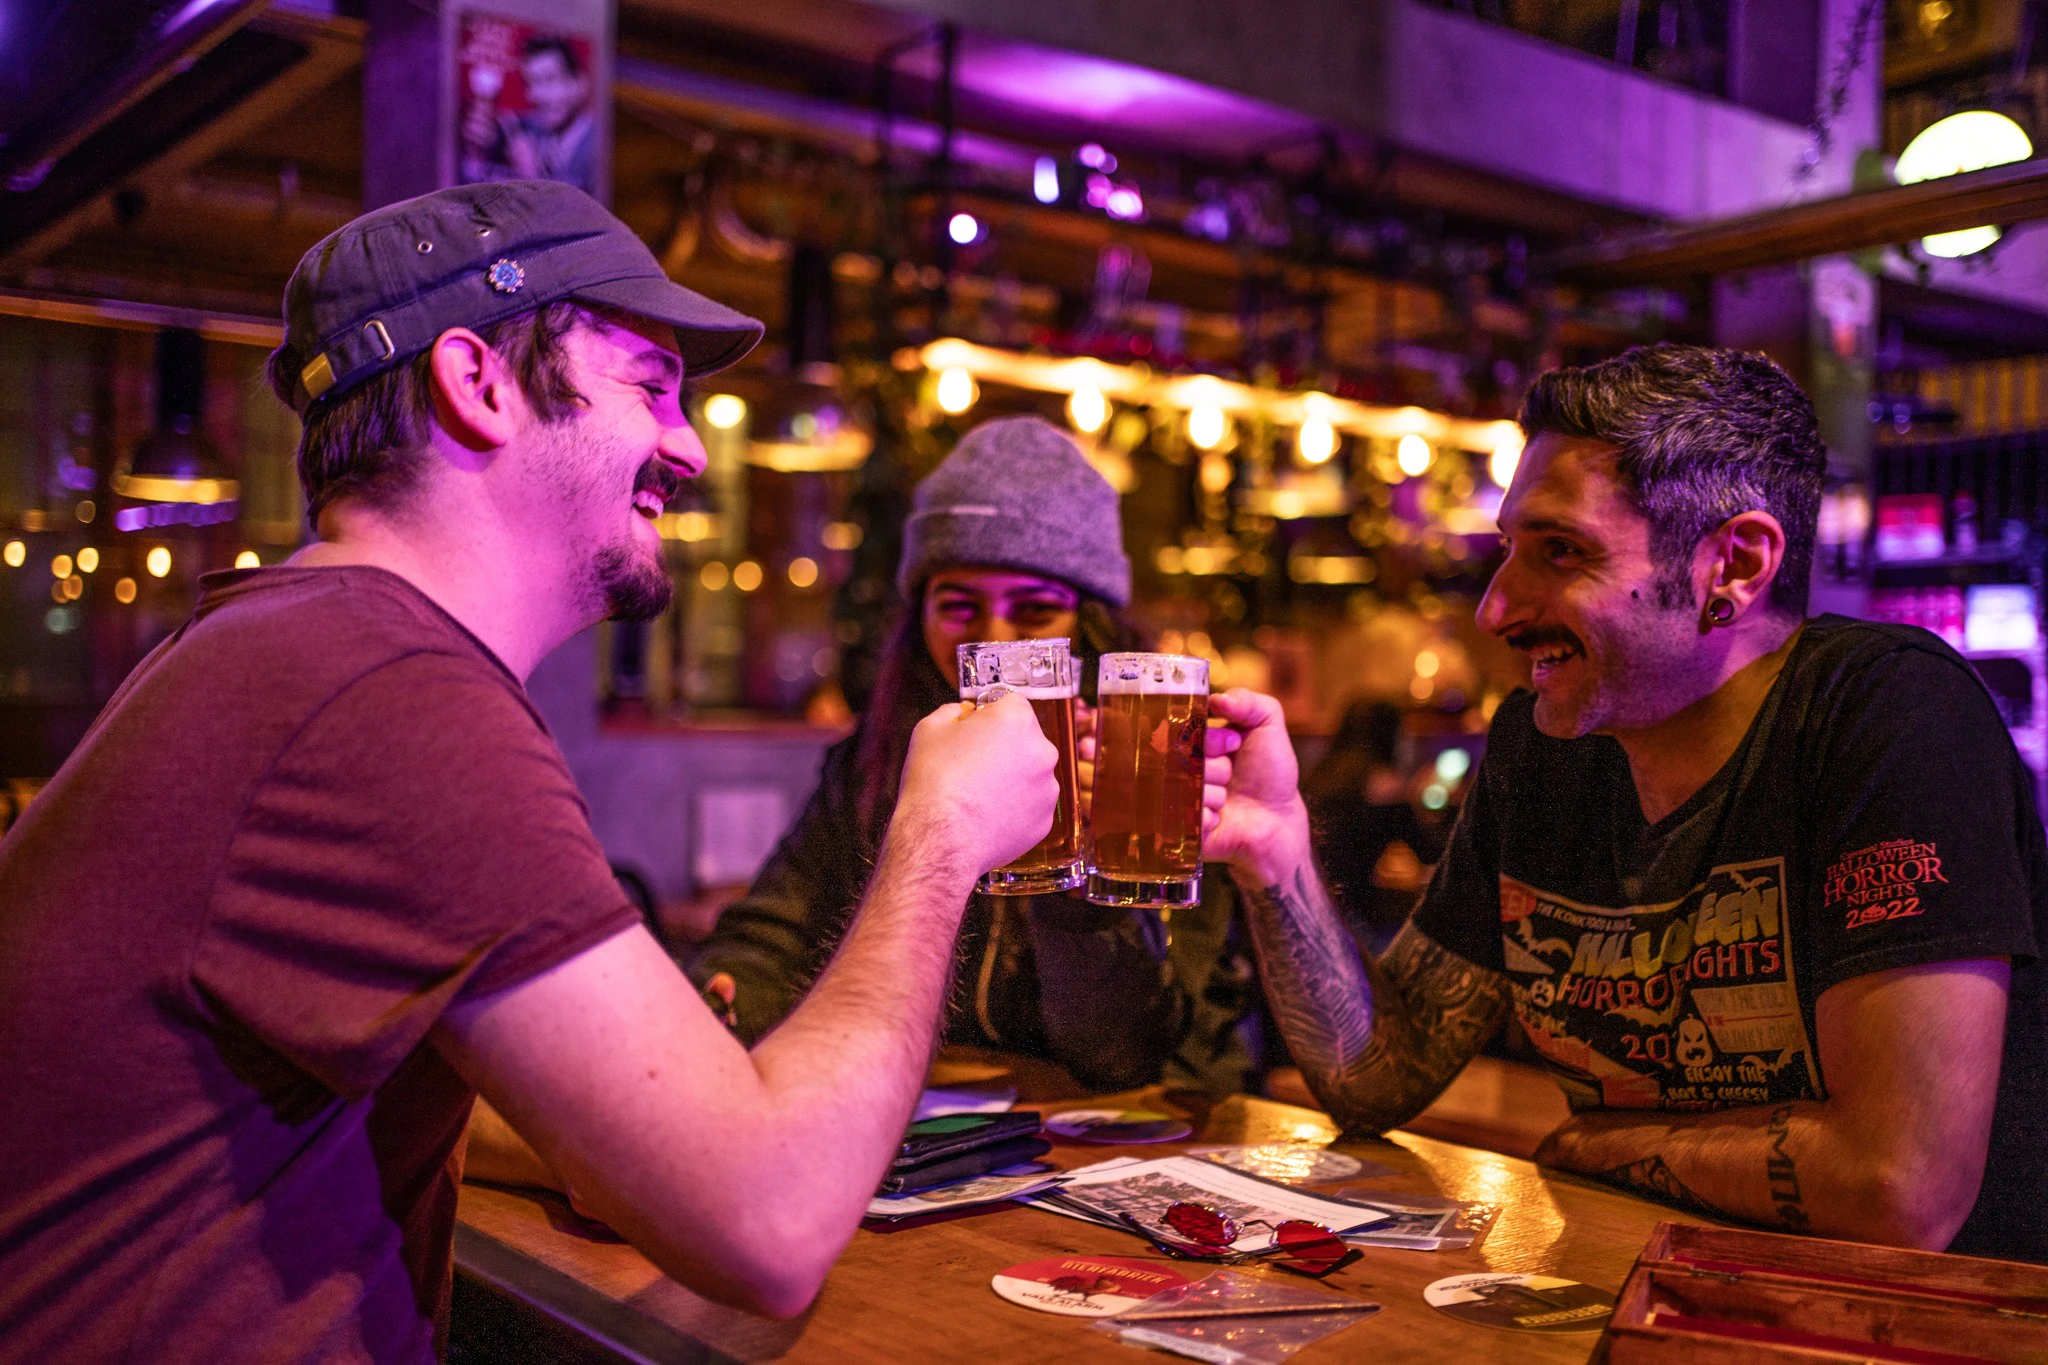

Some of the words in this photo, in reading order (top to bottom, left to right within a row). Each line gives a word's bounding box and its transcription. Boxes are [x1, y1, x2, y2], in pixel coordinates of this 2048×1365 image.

[1826, 842, 1937, 880] HALLOWEEN
[1823, 857, 1950, 908] HORROR
[1846, 881, 1917, 908] NIGHTS
[1684, 1065, 1734, 1083] ENJOY
[1736, 1064, 1768, 1083] THE
[1716, 1085, 1770, 1103] CHEESY
